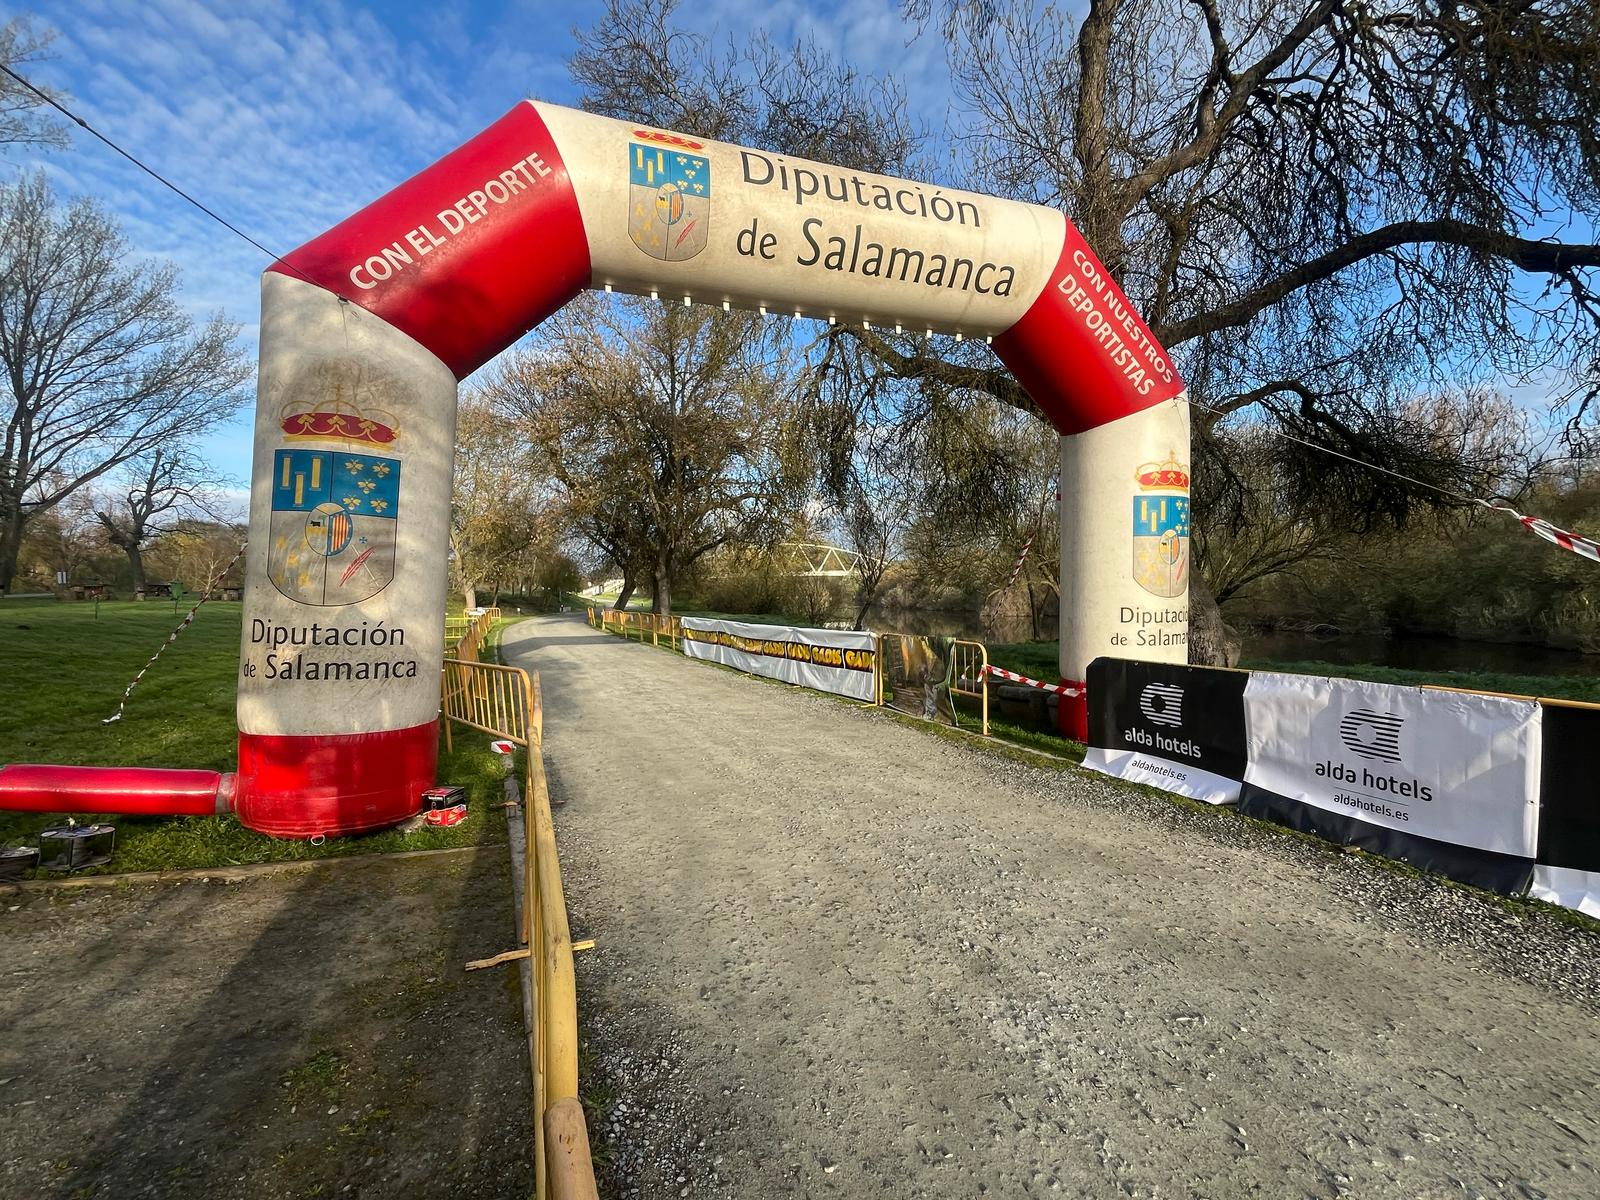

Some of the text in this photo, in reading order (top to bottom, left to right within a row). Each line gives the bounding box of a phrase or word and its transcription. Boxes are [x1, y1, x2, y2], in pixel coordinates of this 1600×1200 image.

[741, 151, 981, 227] Diputación
[350, 152, 552, 289] CON EL DEPORTE
[736, 218, 1016, 297] de Salamanca
[1073, 250, 1173, 384] CON NUESTROS
[1058, 273, 1155, 395] DEPORTISTAS
[252, 618, 405, 650] Diputación
[1110, 628, 1188, 646] de Salama
[243, 654, 417, 680] de Salamanca
[812, 646, 842, 665] GADIS
[845, 650, 875, 669] GADI
[1124, 727, 1202, 758] alda hotels
[1131, 760, 1187, 780] aldahotels.es
[1315, 760, 1433, 801] alda hotels
[1333, 793, 1409, 821] aldahotels.es
